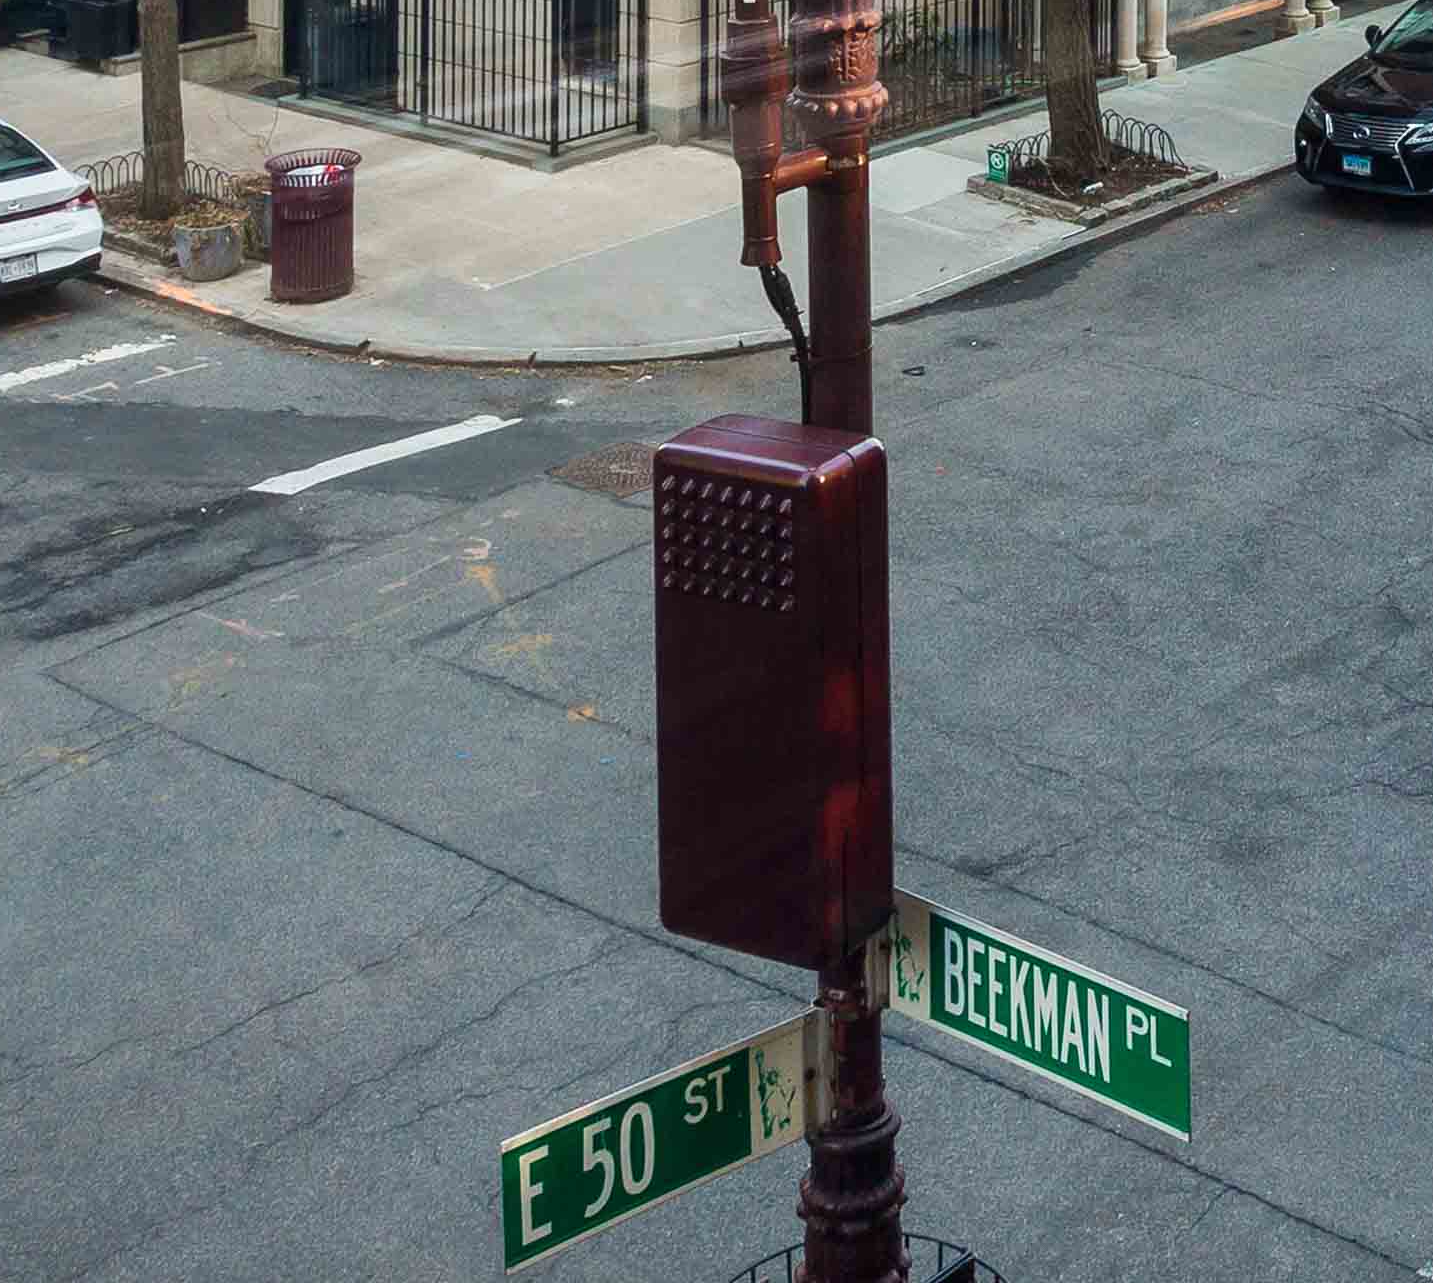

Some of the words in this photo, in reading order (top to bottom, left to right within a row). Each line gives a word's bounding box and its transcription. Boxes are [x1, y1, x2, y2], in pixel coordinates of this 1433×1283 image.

[944, 926, 1111, 1084] BEEKMAN
[1126, 1004, 1173, 1068] PL
[519, 1144, 553, 1246] E
[583, 1101, 655, 1218] 50
[683, 1065, 731, 1124] ST
